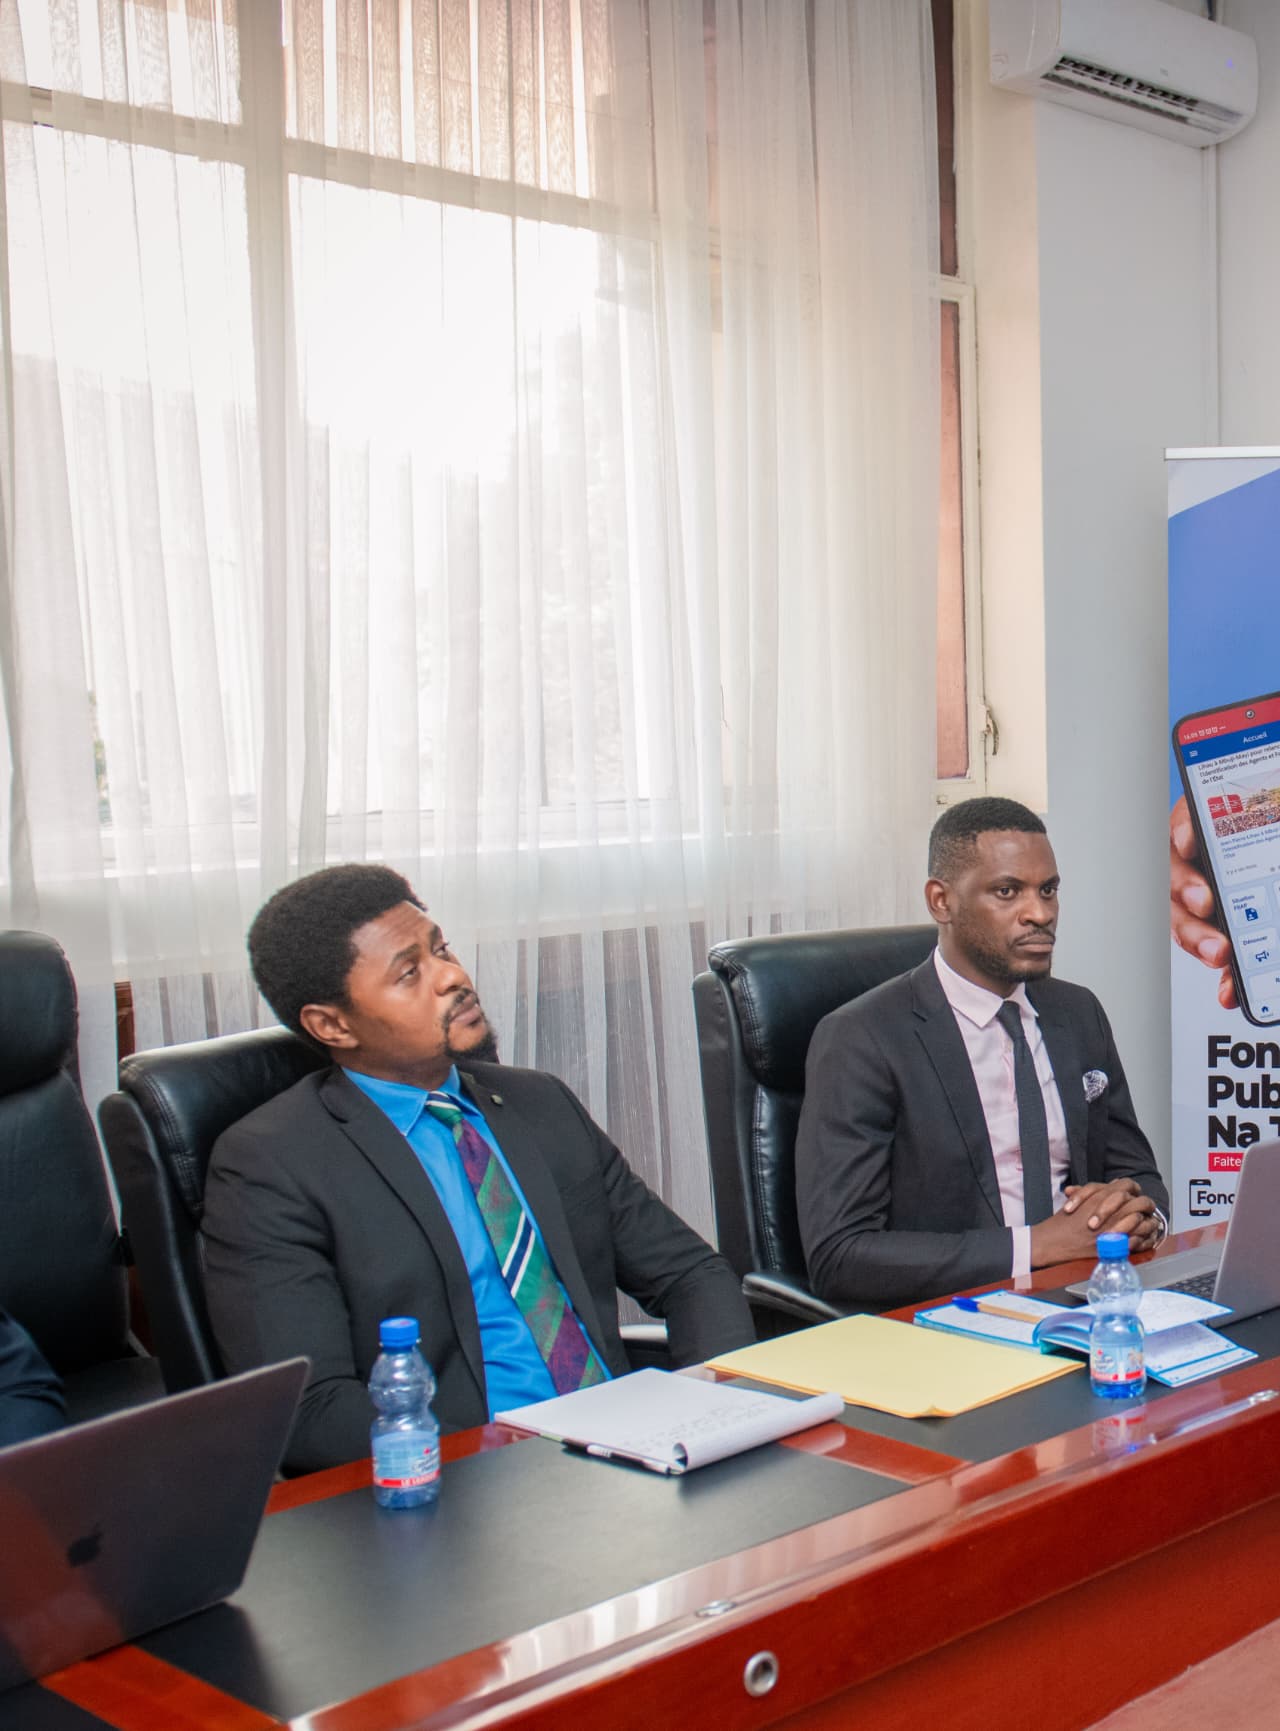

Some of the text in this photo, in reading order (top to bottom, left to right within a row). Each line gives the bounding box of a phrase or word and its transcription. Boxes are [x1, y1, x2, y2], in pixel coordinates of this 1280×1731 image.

[1243, 730, 1268, 744] Accueil
[1250, 748, 1262, 758] pour
[1239, 760, 1248, 768] des
[1249, 755, 1268, 765] Agents
[1208, 1115, 1260, 1149] Na
[1213, 1156, 1242, 1167] Faite
[1197, 1190, 1236, 1205] Fonc
